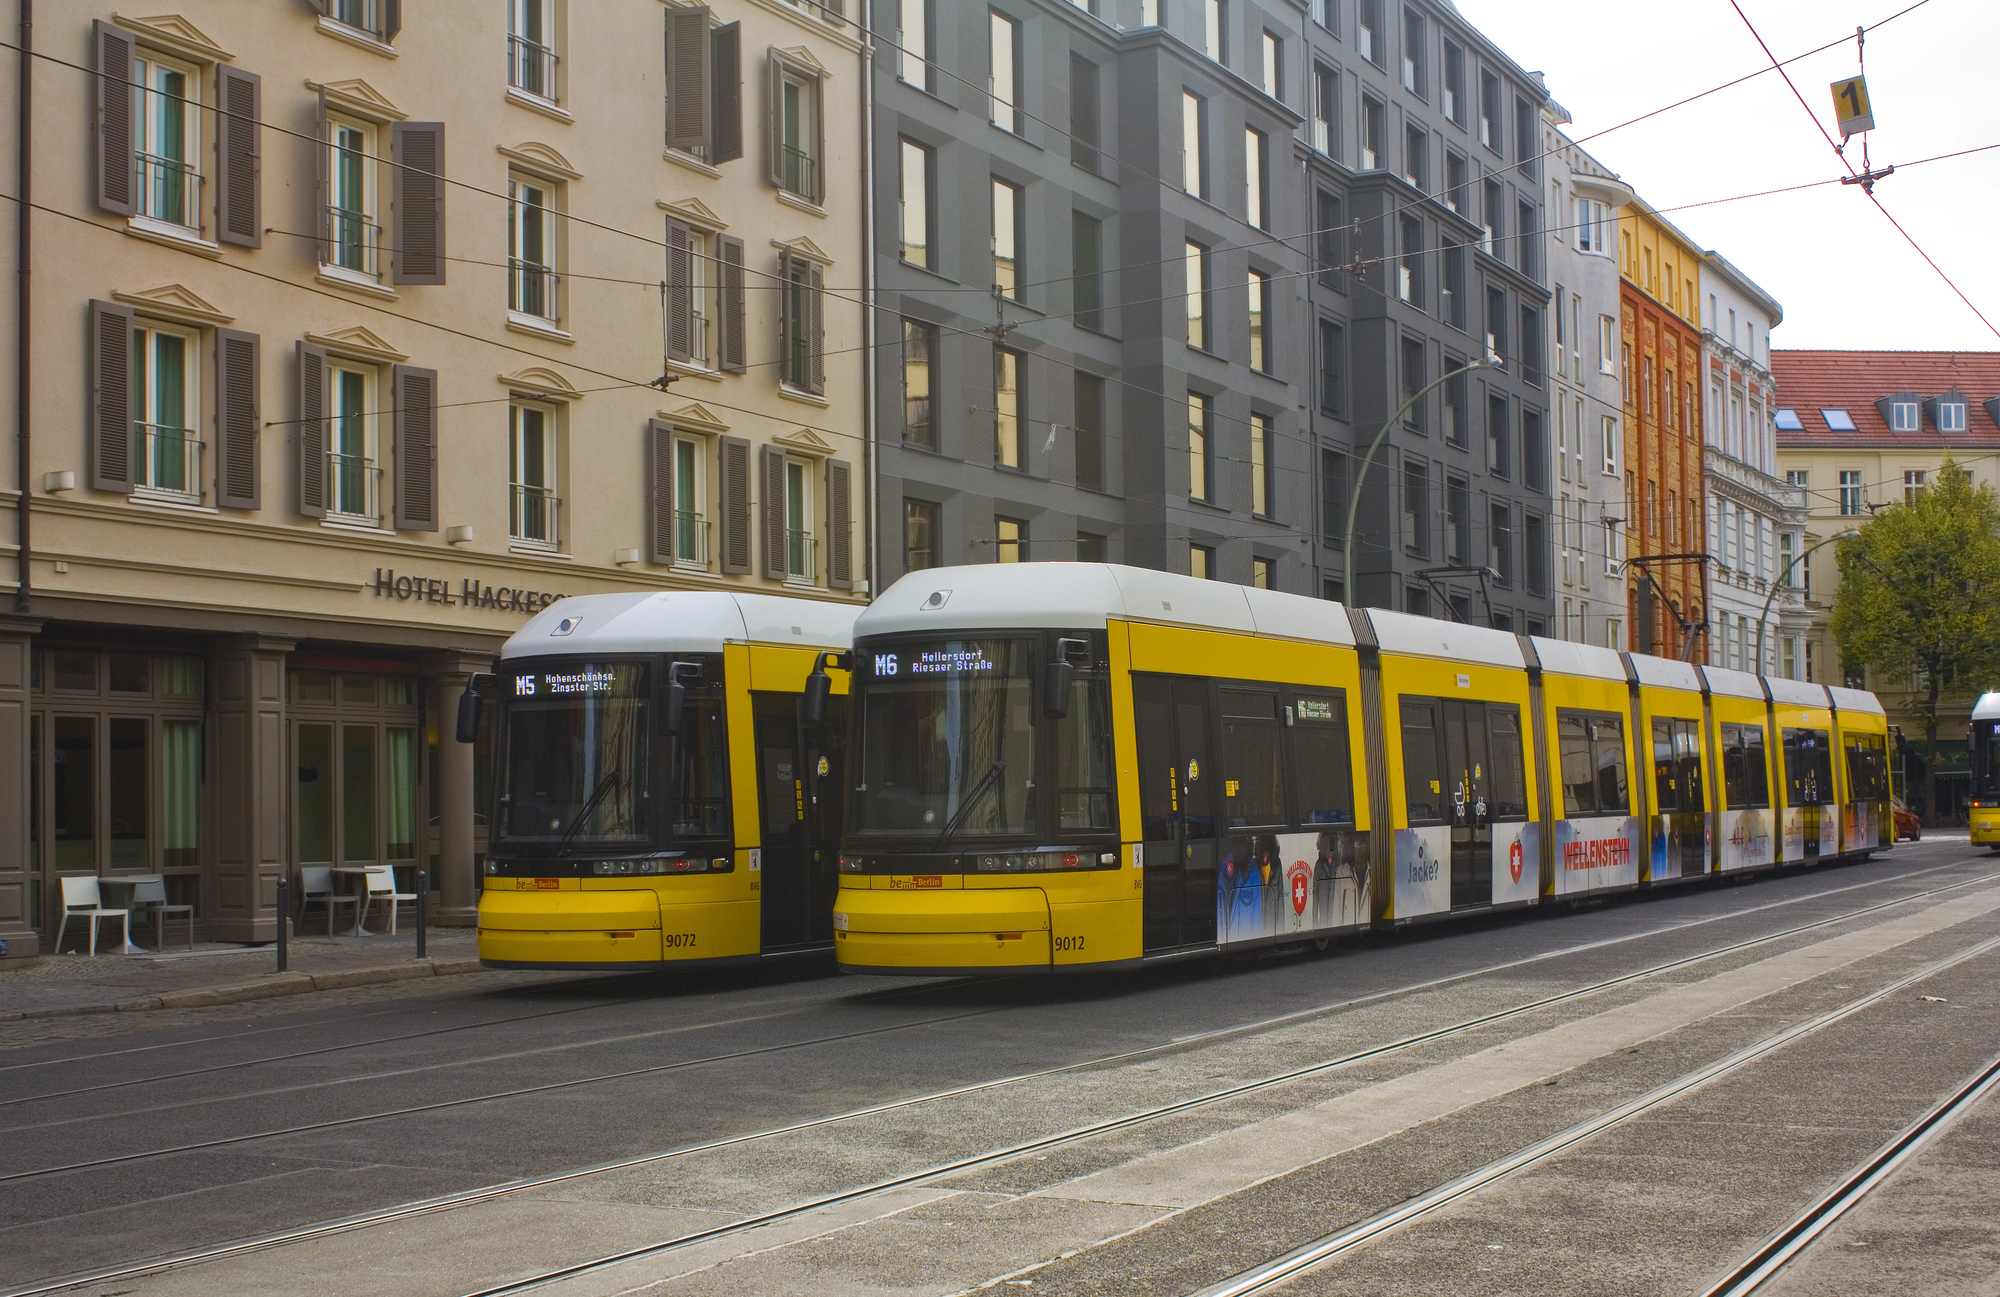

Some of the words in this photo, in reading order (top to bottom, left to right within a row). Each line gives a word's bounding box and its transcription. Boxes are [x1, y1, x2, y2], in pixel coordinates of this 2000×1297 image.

[1841, 81, 1861, 116] 1
[375, 567, 456, 606] HOTEL
[921, 649, 983, 662] Hellersdorf
[875, 653, 898, 676] M6
[912, 661, 952, 673] Riesaer
[956, 659, 993, 671] Straße
[545, 671, 616, 684] Hohenschönhsn.
[515, 675, 536, 696] M5
[551, 682, 590, 693] Zingster
[593, 681, 611, 691] Str.
[1563, 837, 1630, 872] WELLENSTEYN
[1407, 859, 1439, 884] Jacke?
[538, 880, 558, 888] Berlin
[889, 875, 902, 889] be
[917, 878, 940, 886] Berlin
[665, 933, 697, 948] 9072
[1054, 935, 1085, 951] 9012
